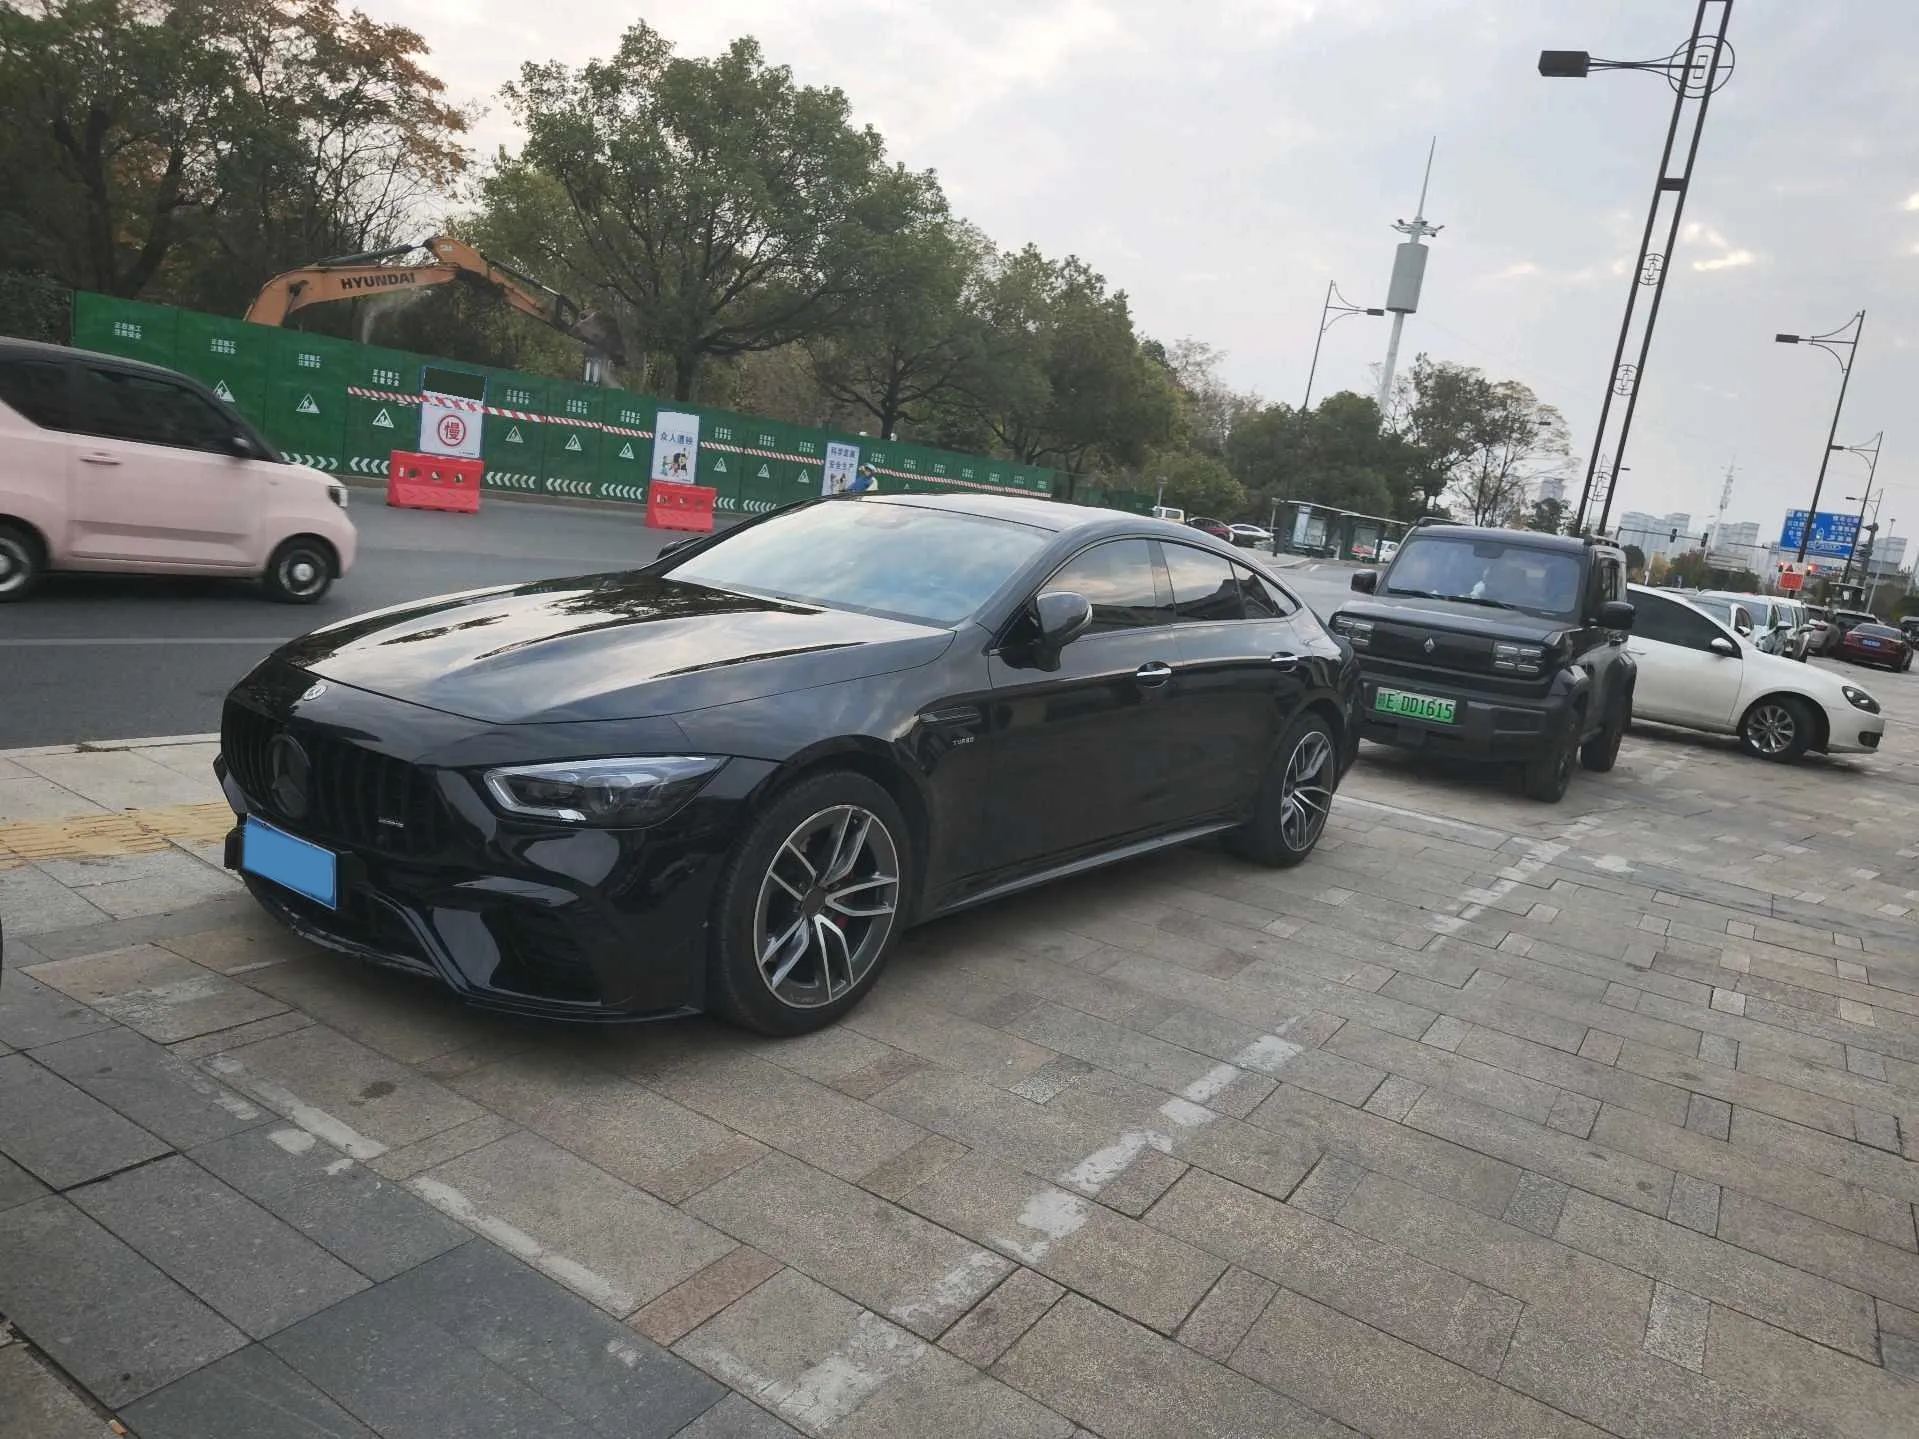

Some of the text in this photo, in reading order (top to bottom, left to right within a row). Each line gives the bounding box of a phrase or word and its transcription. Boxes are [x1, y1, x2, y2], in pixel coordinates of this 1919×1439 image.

[341, 272, 416, 290] HYUNDAI
[444, 420, 461, 441] 慢
[952, 736, 975, 747] TURBO
